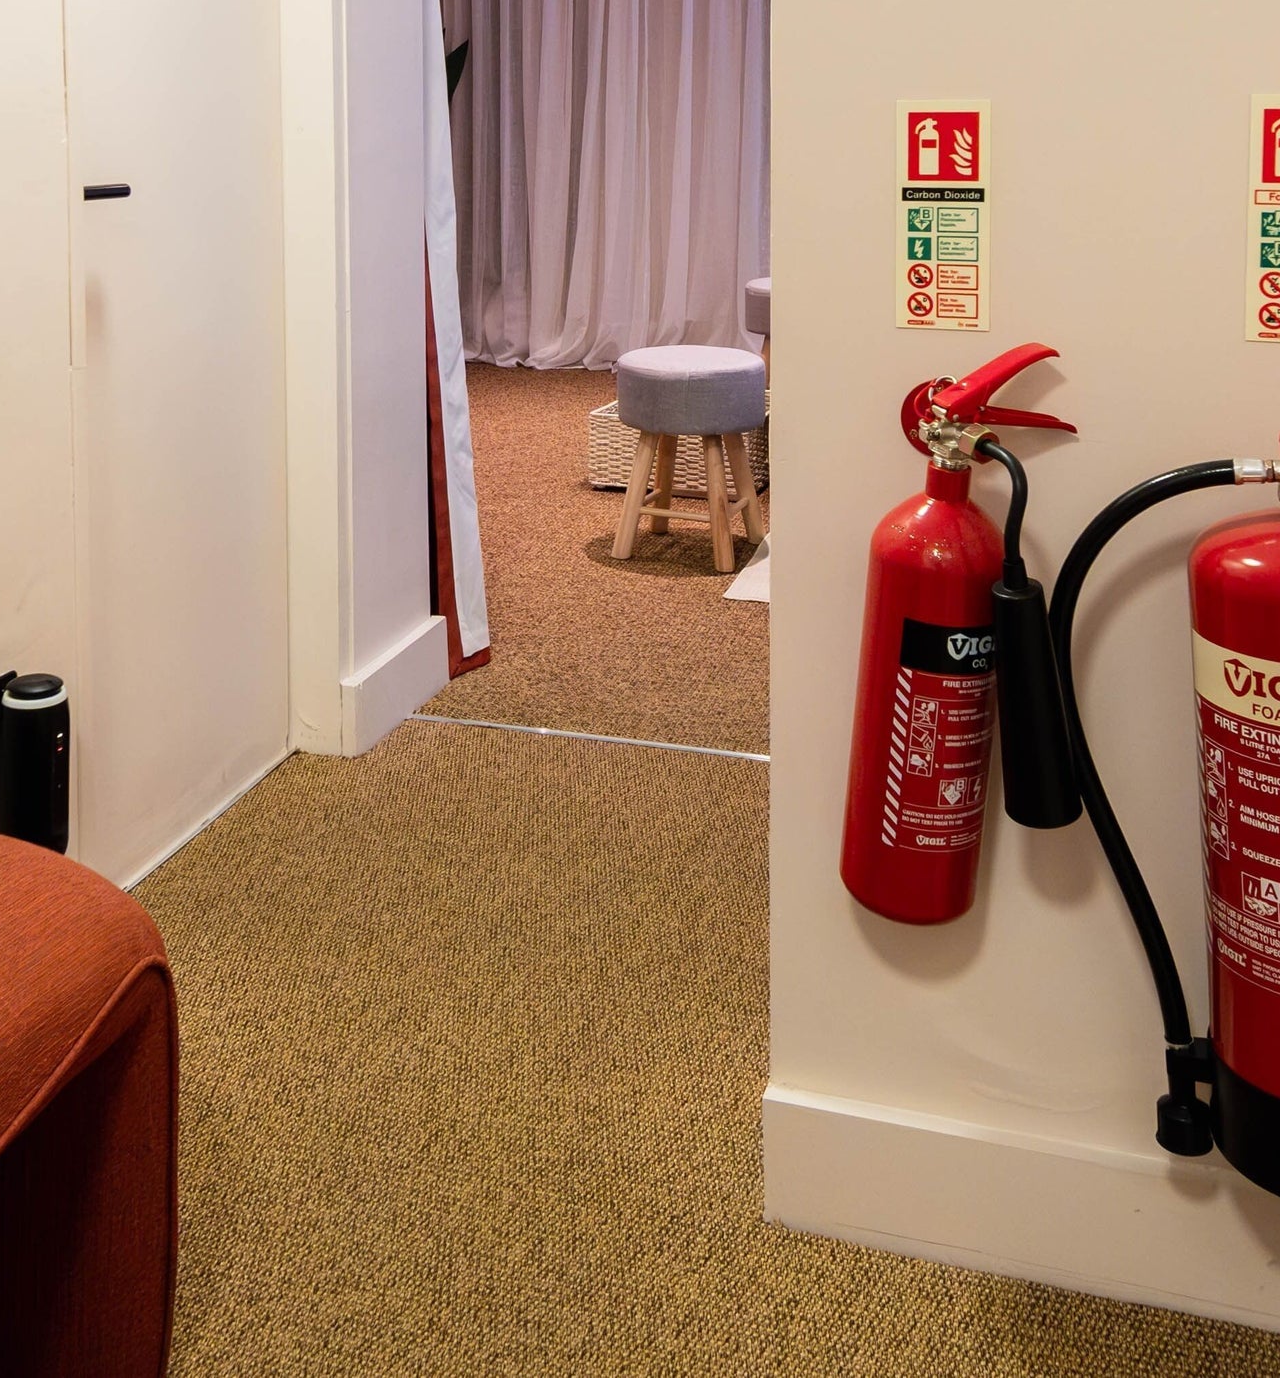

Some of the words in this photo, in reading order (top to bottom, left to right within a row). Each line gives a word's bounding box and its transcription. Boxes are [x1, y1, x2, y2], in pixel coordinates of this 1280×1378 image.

[906, 190, 941, 199] Carbon
[944, 190, 981, 199] Dioxide
[922, 209, 930, 219] B
[947, 633, 995, 660] VIG
[1214, 713, 1239, 734] FIRE
[1245, 739, 1265, 751] LITRE
[1237, 765, 1254, 779] USE
[956, 779, 965, 791] B
[1238, 776, 1260, 791] PULL
[1260, 784, 1280, 796] OUT
[1228, 799, 1235, 809] 2.
[1239, 804, 1255, 817] AIM
[1255, 809, 1280, 825] HOSE
[1239, 813, 1280, 834] MINIMUM
[916, 834, 947, 846] VIGIL
[1264, 882, 1279, 900] A
[1240, 924, 1259, 940] PRIOR
[1259, 932, 1269, 944] TO
[1242, 916, 1277, 937] PRESSURE
[1238, 932, 1264, 952] OUTSIDE
